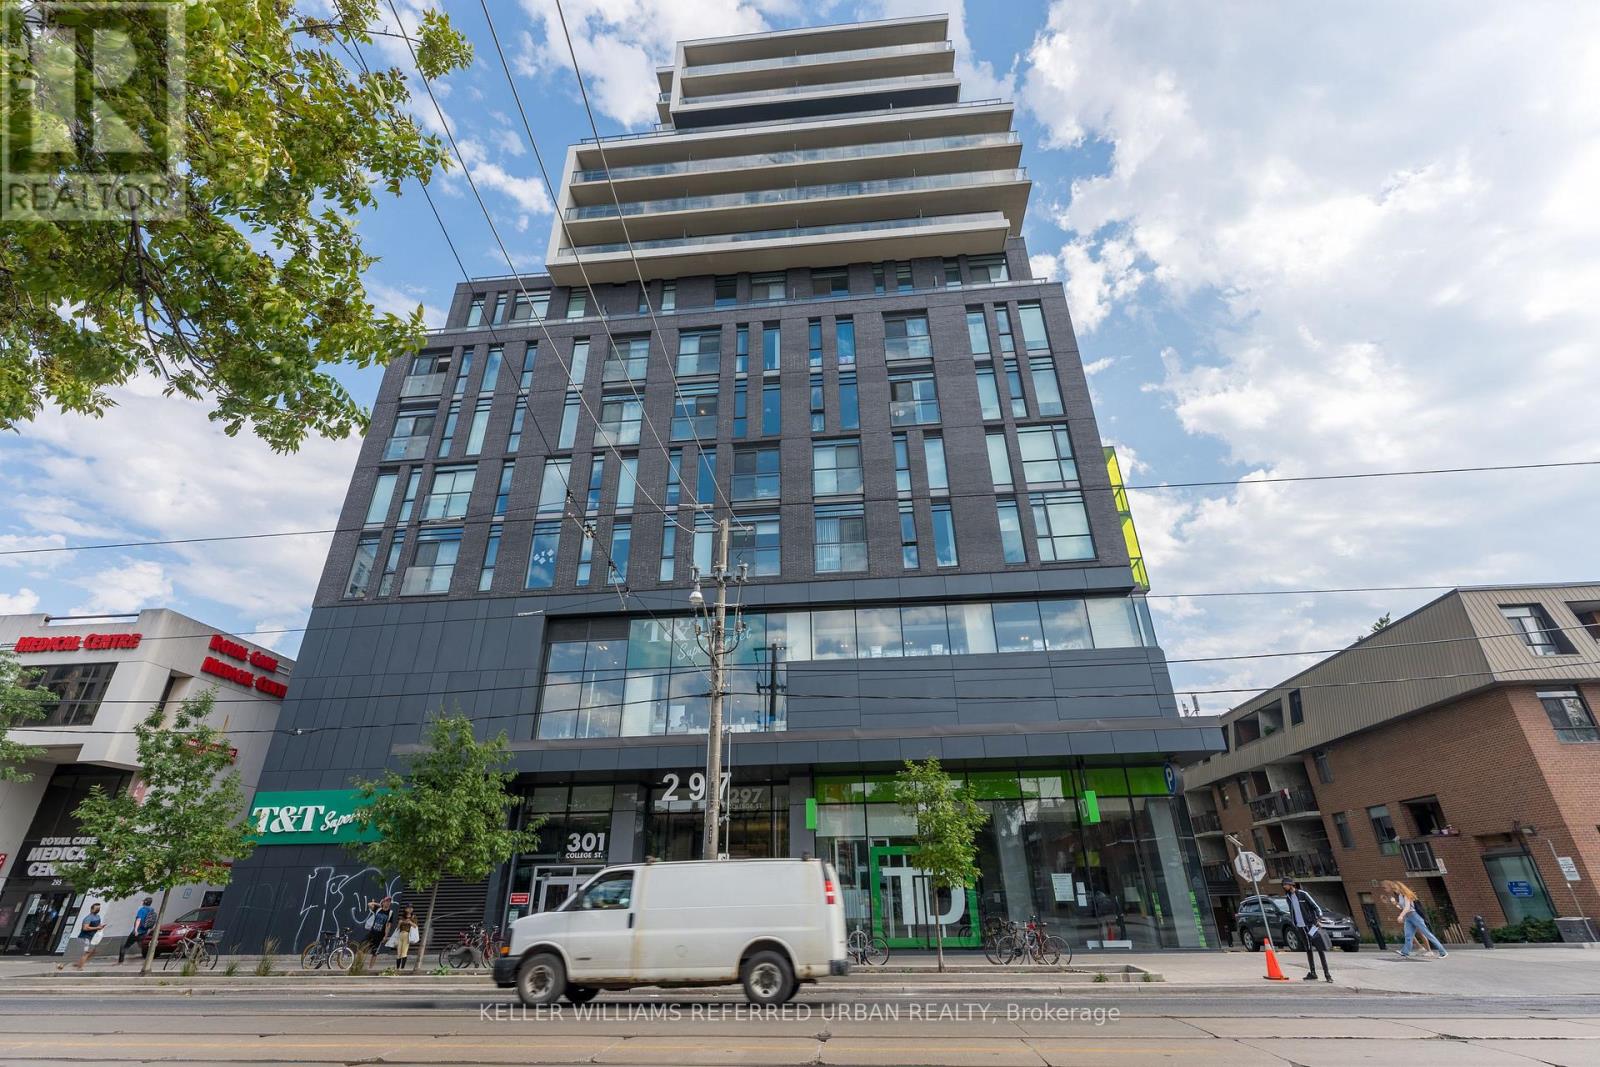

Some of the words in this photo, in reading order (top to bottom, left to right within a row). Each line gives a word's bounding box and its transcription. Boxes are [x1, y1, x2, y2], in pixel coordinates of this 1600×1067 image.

[662, 772, 732, 801] 297
[252, 805, 325, 833] T&T
[40, 837, 71, 845] ROYAL
[72, 836, 98, 845] CARE
[567, 832, 605, 852] 301
[26, 847, 87, 861] MEDICA
[882, 867, 966, 925] TD
